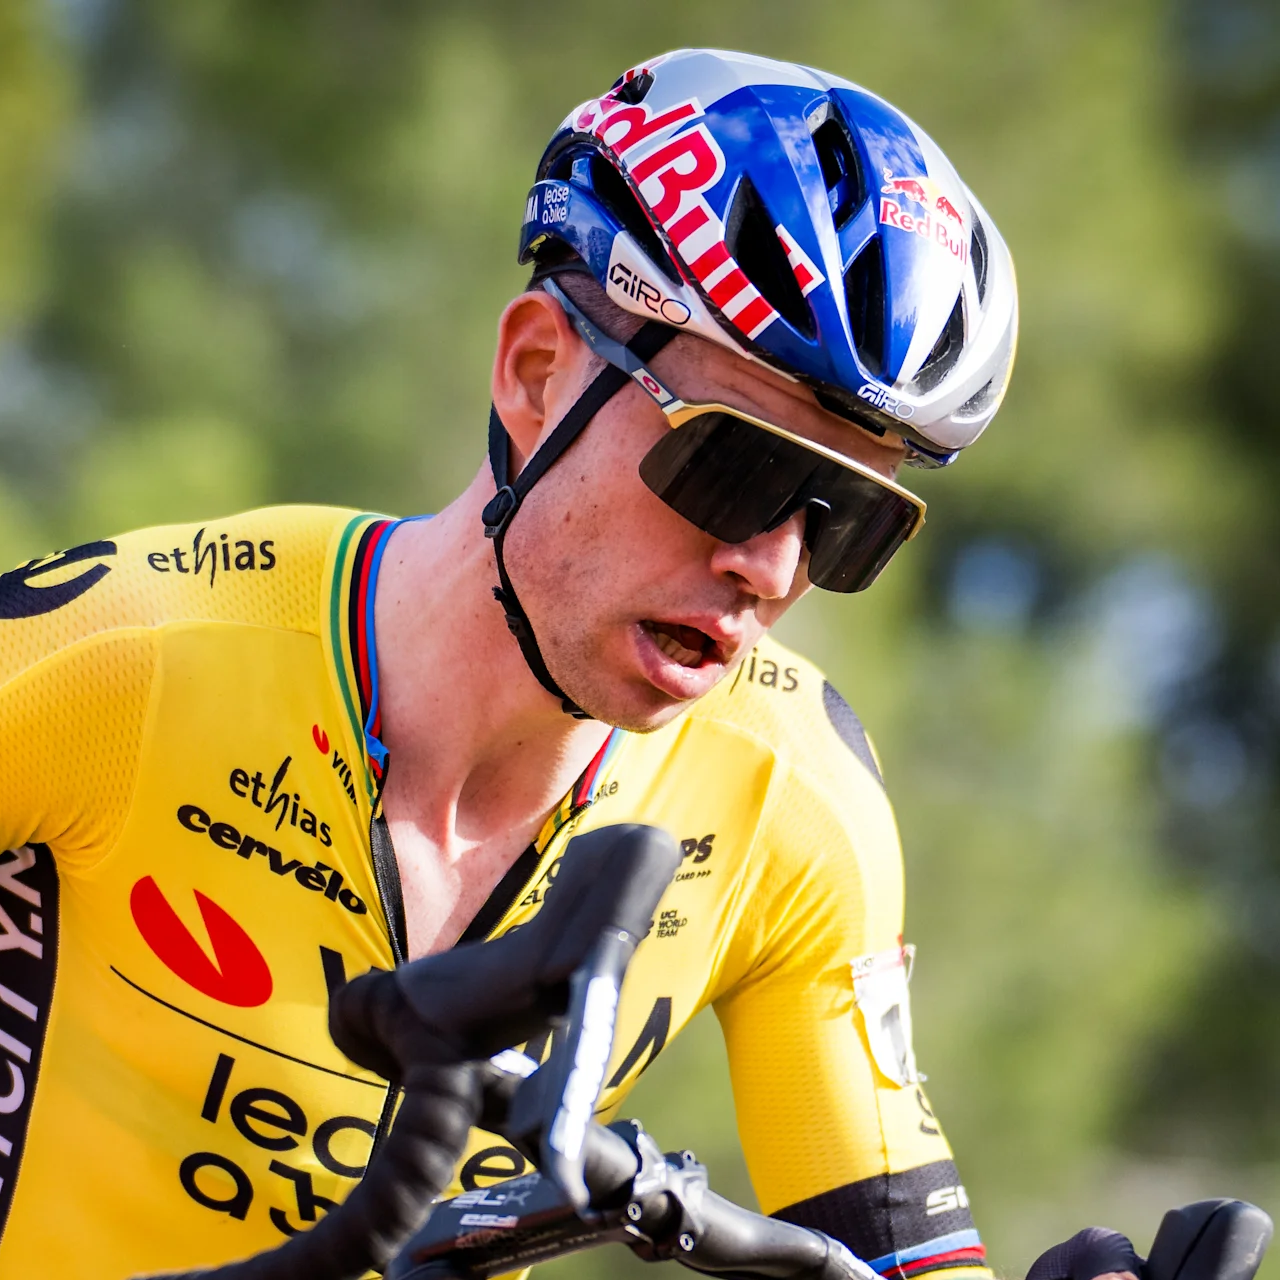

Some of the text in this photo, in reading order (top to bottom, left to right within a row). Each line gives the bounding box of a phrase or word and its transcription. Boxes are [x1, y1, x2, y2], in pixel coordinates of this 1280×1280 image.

[544, 187, 569, 204] lease
[880, 199, 969, 266] Red Bull
[609, 262, 692, 325] GIRO
[857, 384, 915, 419] GIRO
[147, 527, 277, 589] ethias
[229, 756, 334, 848] ethias
[177, 803, 368, 916] cervélo
[656, 928, 678, 939] TEAM
[658, 917, 688, 929] WORLD
